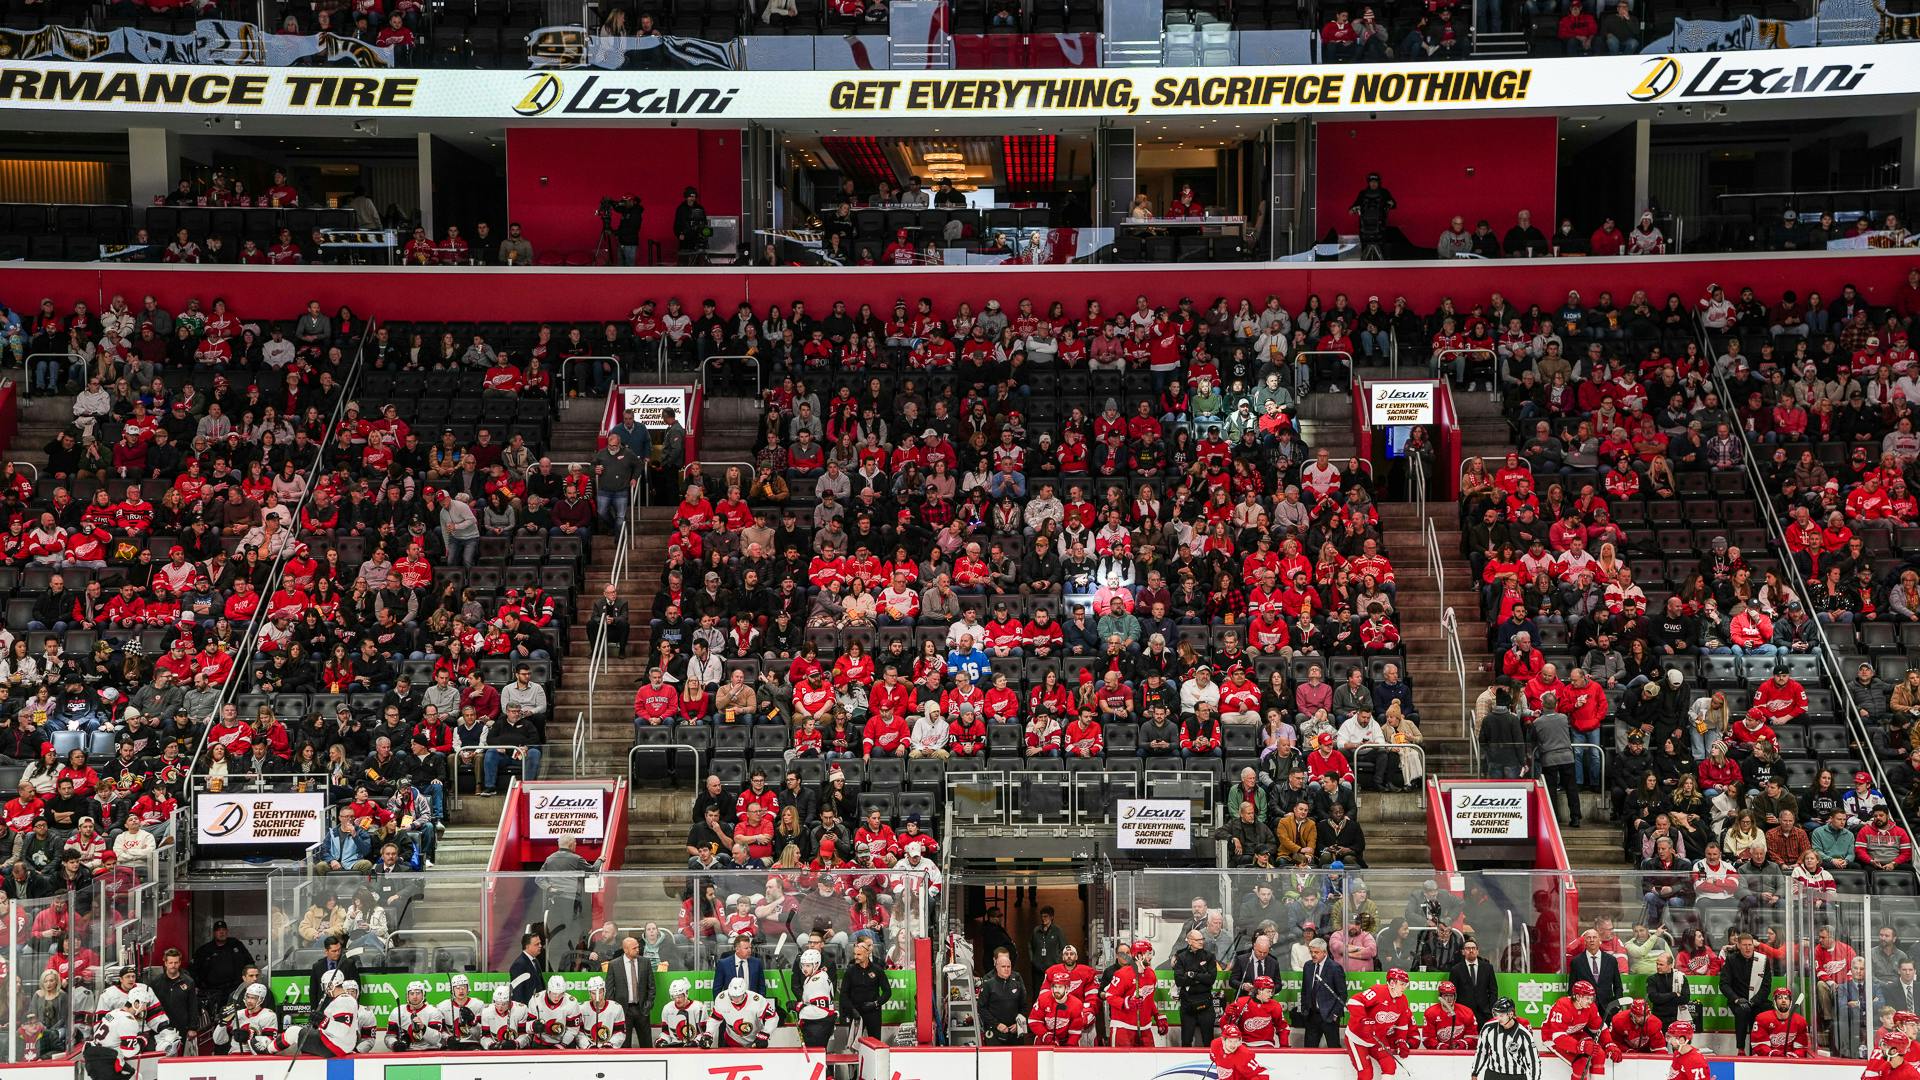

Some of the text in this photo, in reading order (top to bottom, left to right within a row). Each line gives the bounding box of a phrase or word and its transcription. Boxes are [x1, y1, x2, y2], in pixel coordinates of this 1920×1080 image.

[284, 76, 419, 108] TIRE
[830, 69, 1533, 114] GET EVERYTHING, SACRIFICE NOTHING!
[962, 662, 979, 680] 16
[655, 696, 669, 704] WINGS
[1758, 766, 1770, 774] PLAY
[253, 801, 273, 810] GET
[253, 810, 317, 820] EVERYTHING,
[550, 812, 599, 820] EVERYTHING,
[253, 819, 305, 828] SACRIFICE
[253, 828, 300, 837] NOTHING!
[866, 834, 872, 842] C
[1111, 976, 1120, 986] 27
[1689, 985, 1715, 995] ELTA
[815, 999, 825, 1008] 19
[1551, 1011, 1562, 1023] 20
[126, 1038, 138, 1048] 72
[1691, 1067, 1706, 1080] 71
